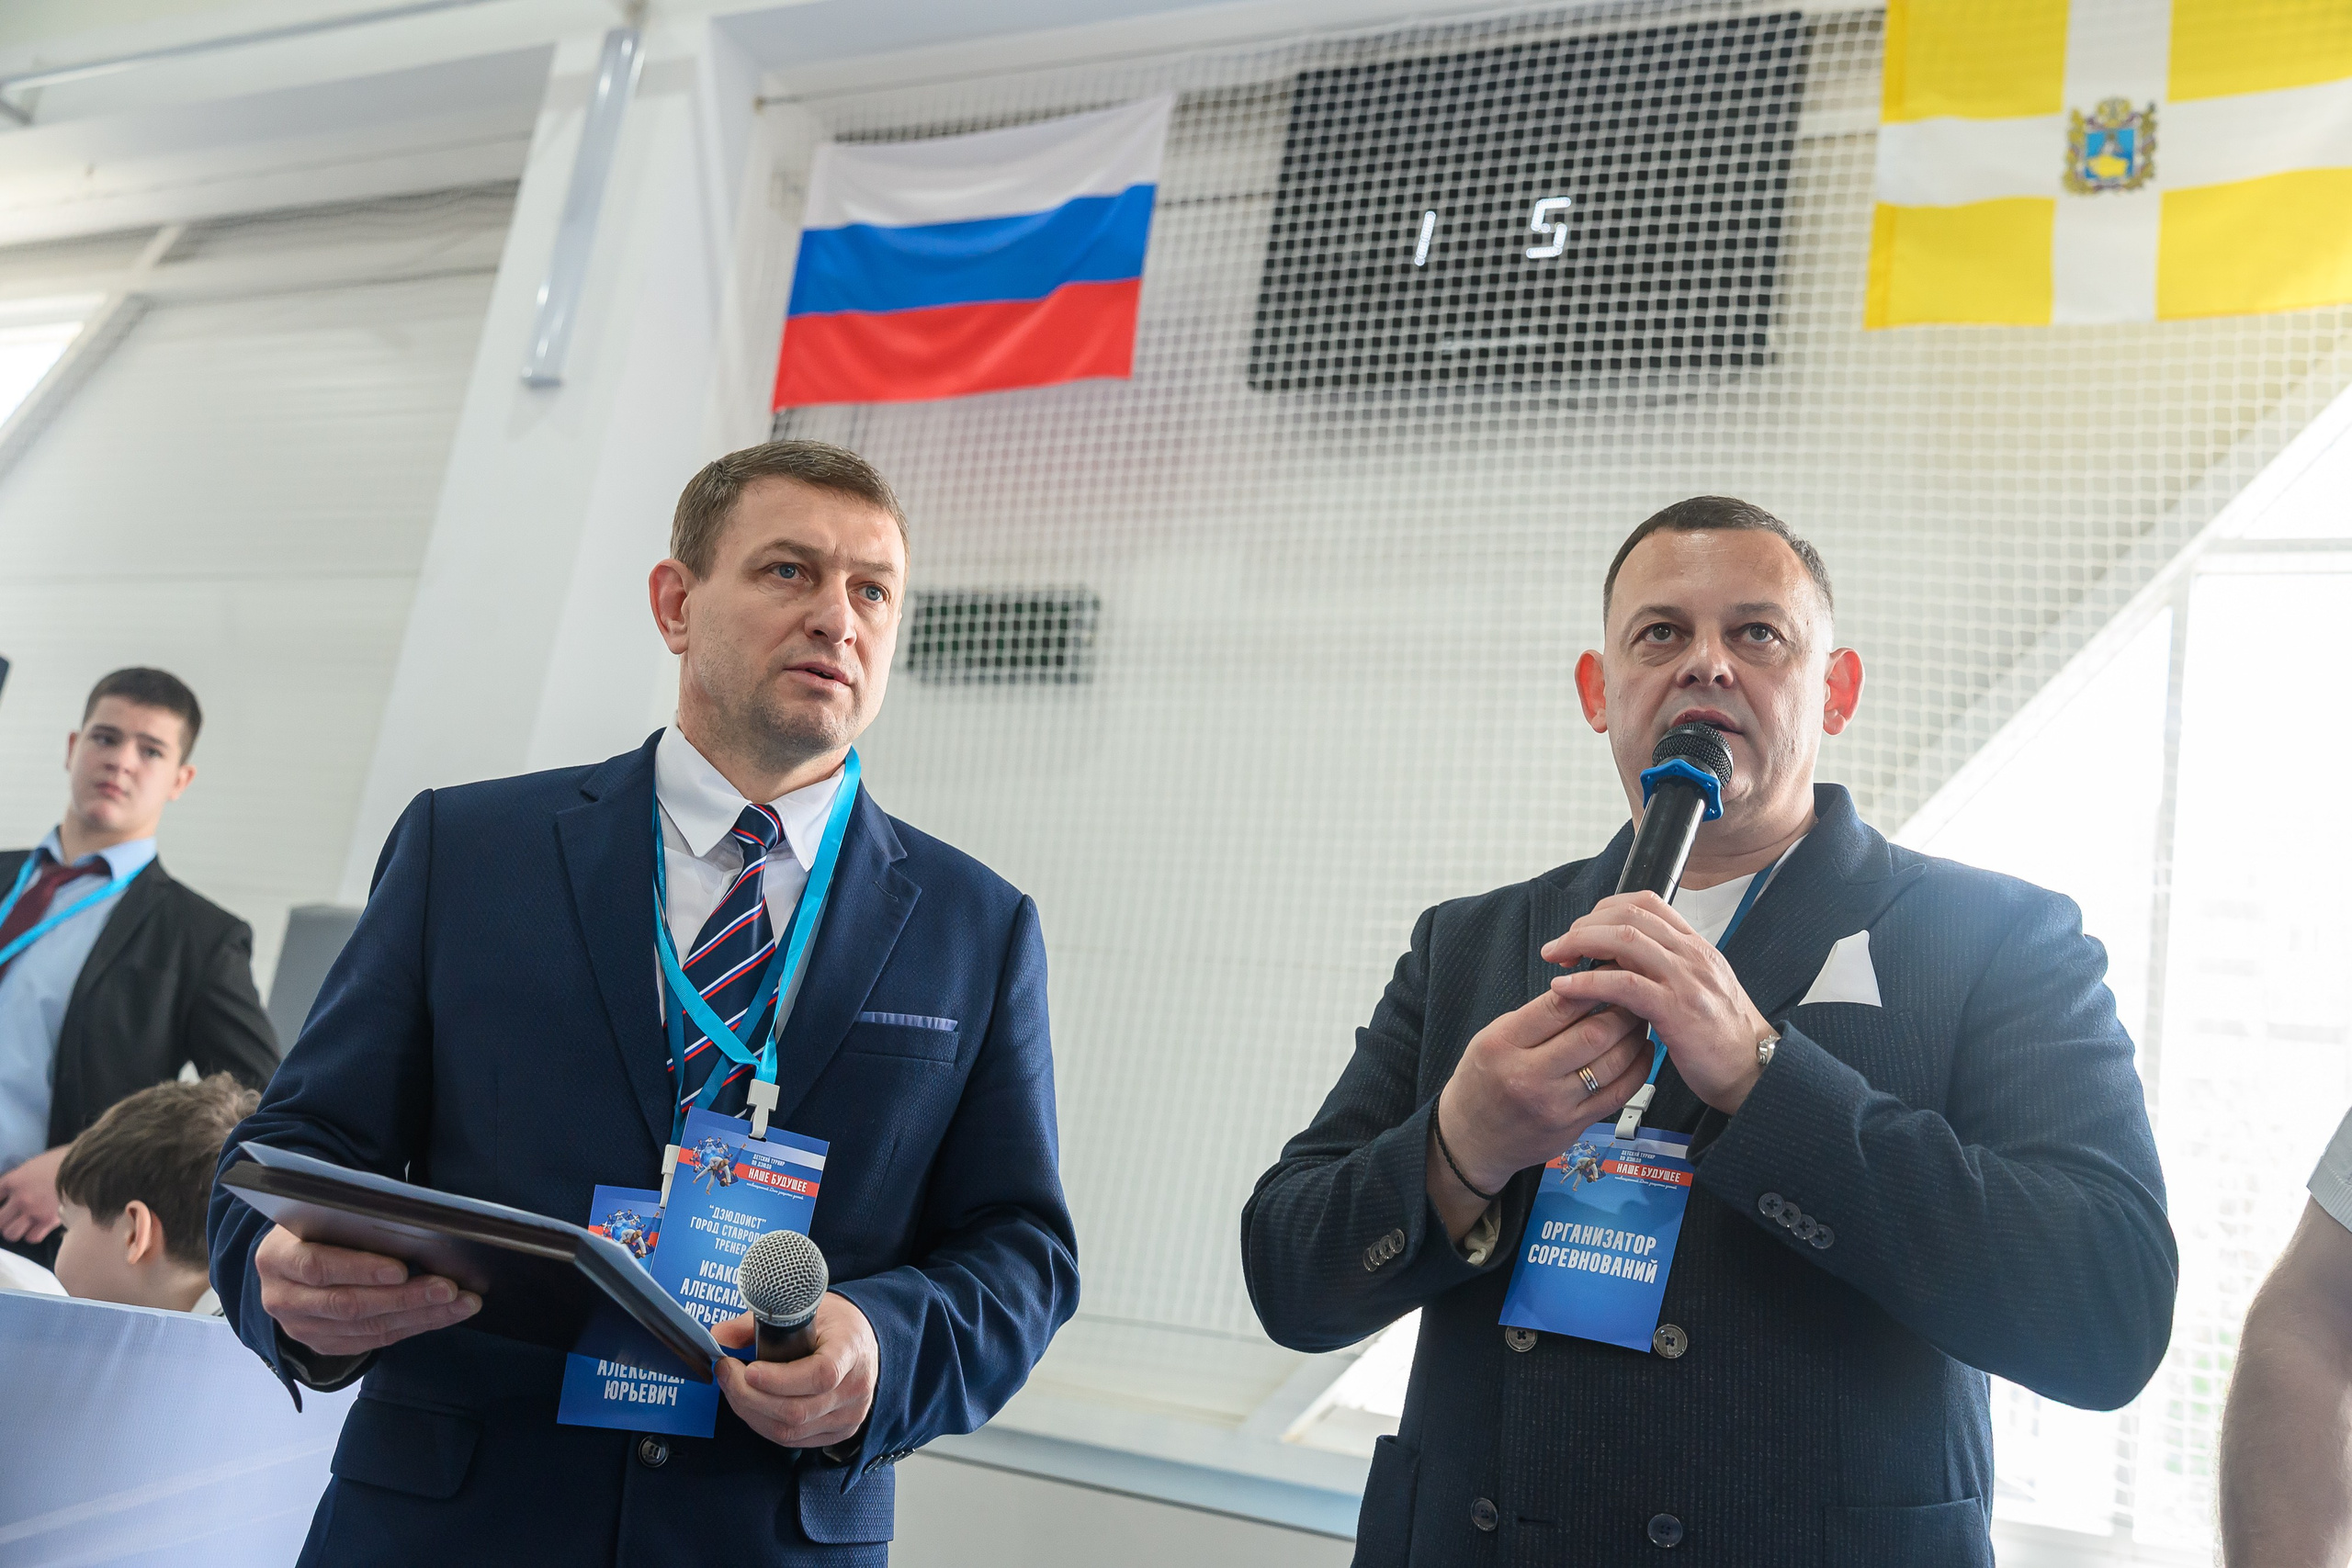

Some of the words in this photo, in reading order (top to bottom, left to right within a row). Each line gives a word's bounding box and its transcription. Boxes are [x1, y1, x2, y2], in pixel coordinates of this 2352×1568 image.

[1526, 197, 1571, 259] 5
[771, 1156, 786, 1167] ТУРНИР
[1616, 1163, 1640, 1176] НАШЕ
[748, 1168, 771, 1183] НАШЕ
[690, 1216, 720, 1235] ГОРОД
[721, 1224, 766, 1243] СТАВРОП
[1541, 1220, 1657, 1257] ОРГАНИЗАТОР
[715, 1237, 747, 1256] ТРЕНЕР
[699, 1259, 740, 1285] ИСАКО
[1527, 1244, 1658, 1284] СОРЕВНОВАНИЙ
[680, 1278, 748, 1310] АЛЕКСАНД
[684, 1301, 741, 1325] ЮРЬЕВИ
[604, 1380, 678, 1406] ЮРЬЕВИЧ
